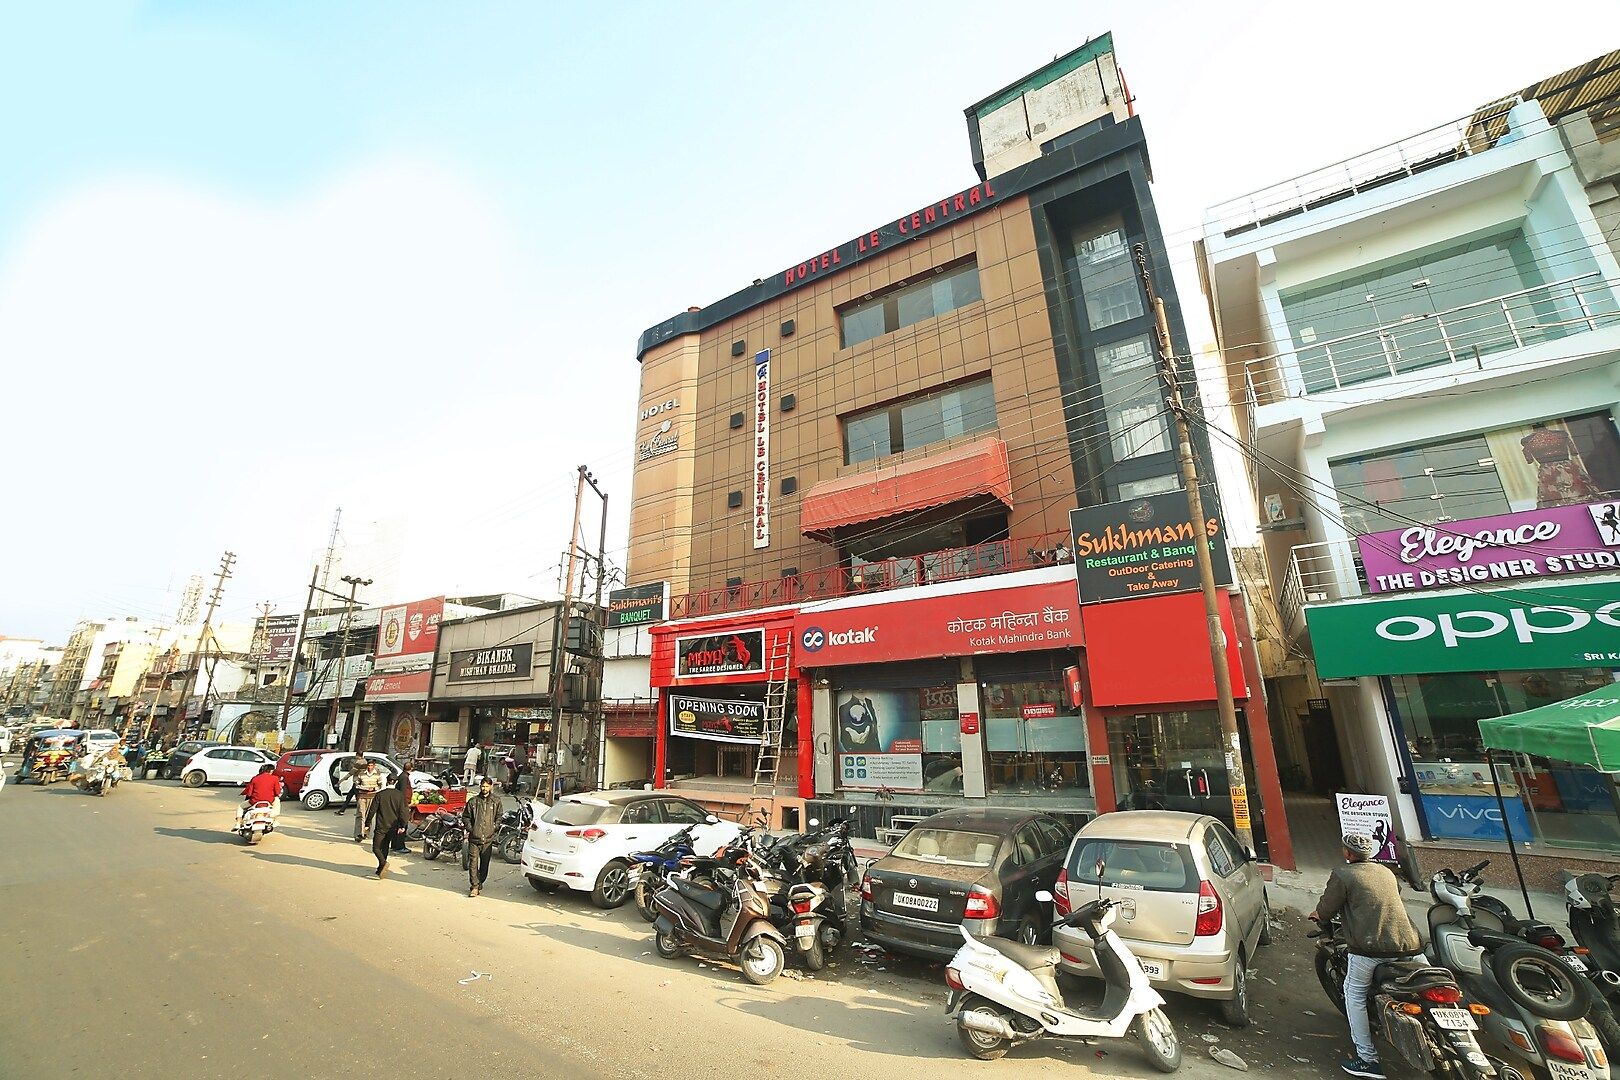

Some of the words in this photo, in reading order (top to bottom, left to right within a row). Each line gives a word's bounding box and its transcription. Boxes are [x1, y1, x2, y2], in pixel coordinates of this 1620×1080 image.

[785, 249, 841, 286] HOTEL
[858, 231, 880, 252] LE
[898, 181, 995, 234] CENTRAL
[641, 398, 680, 421] HOTEL
[757, 381, 767, 433] HOTEL
[756, 437, 765, 457] LE
[756, 461, 766, 540] CENTRAL
[1400, 520, 1561, 565] Elegance
[1086, 550, 1148, 569] Restaurant
[1151, 549, 1160, 559] &
[1108, 565, 1149, 577] OutDoor
[1151, 559, 1194, 571] Catering
[1147, 572, 1156, 580] &
[1377, 572, 1416, 592] THE
[1420, 559, 1540, 587] DESIGNER
[1127, 583, 1150, 592] Take
[1151, 578, 1179, 589] Away
[610, 595, 662, 611] Sukhmani's
[620, 609, 651, 624] BANQUET
[947, 617, 987, 634] कोटक
[990, 611, 1039, 630] महिन्द्रा
[1043, 606, 1070, 624] बैंक
[828, 628, 876, 647] kotak
[969, 635, 996, 647] Kotak
[998, 631, 1044, 644] Mahindra
[1046, 628, 1071, 640] Bank
[476, 649, 513, 665] BIKANER
[489, 664, 517, 675] BHANDAR
[716, 663, 744, 671] DESIGNER
[369, 680, 385, 691] ACC
[679, 700, 725, 714] OPENING
[728, 704, 758, 717] SOON
[1341, 797, 1385, 810] Elegance
[1443, 1019, 1470, 1028] 7134
